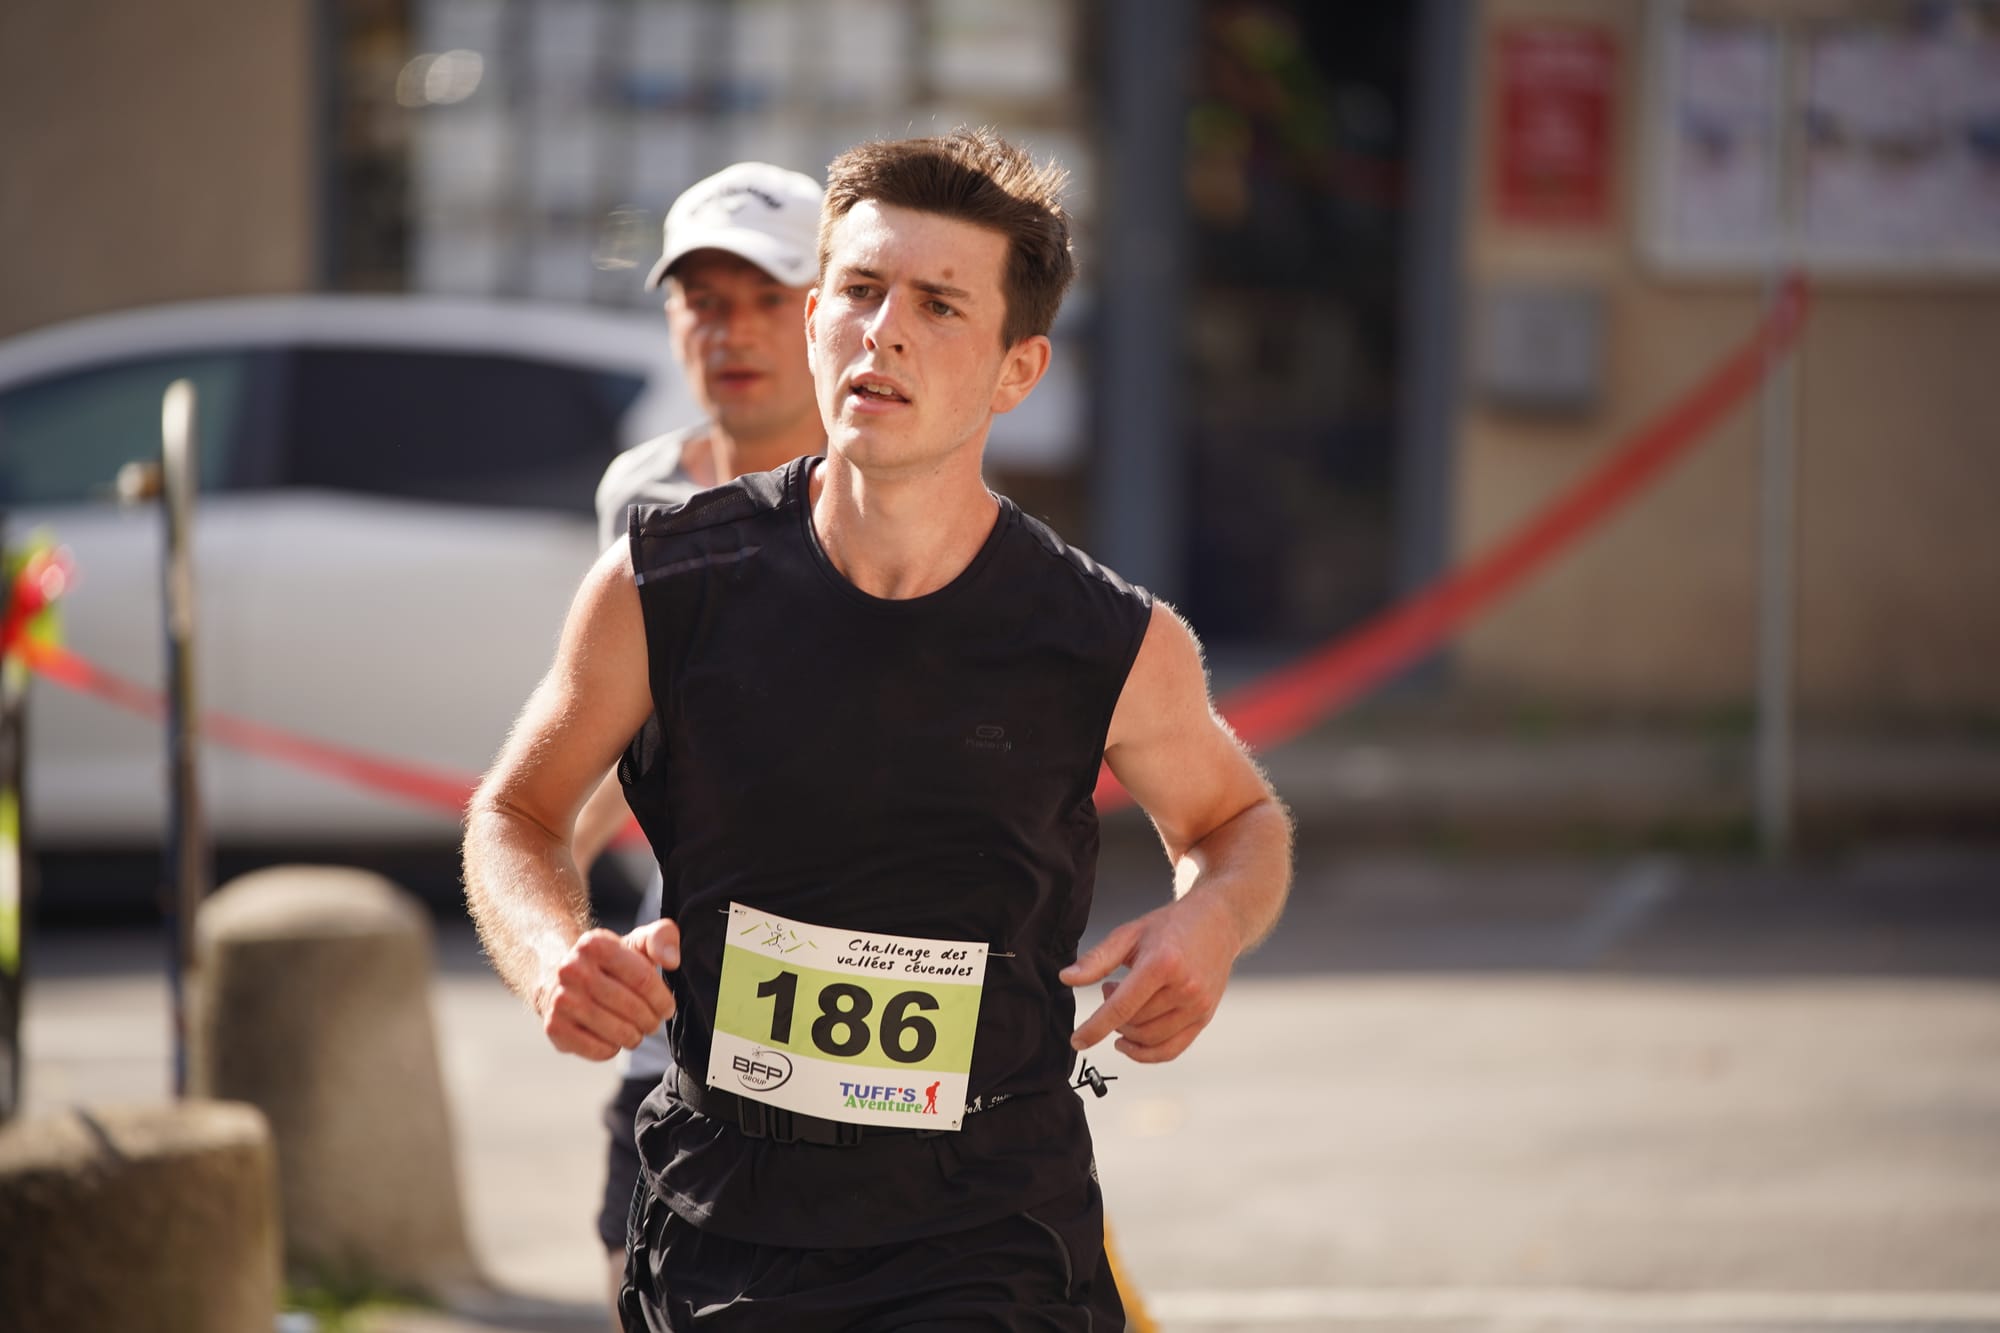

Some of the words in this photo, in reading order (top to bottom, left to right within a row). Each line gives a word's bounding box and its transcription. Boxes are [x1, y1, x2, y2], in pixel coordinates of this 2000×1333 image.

[848, 939, 931, 962] Challenge
[941, 949, 968, 960] des
[837, 955, 895, 970] vallées
[904, 961, 974, 977] cévenoles
[757, 971, 940, 1064] 186
[732, 1055, 783, 1080] BFP
[742, 1074, 767, 1086] GROUP
[839, 1082, 916, 1102] TUFF'S
[844, 1094, 923, 1114] Aventure
